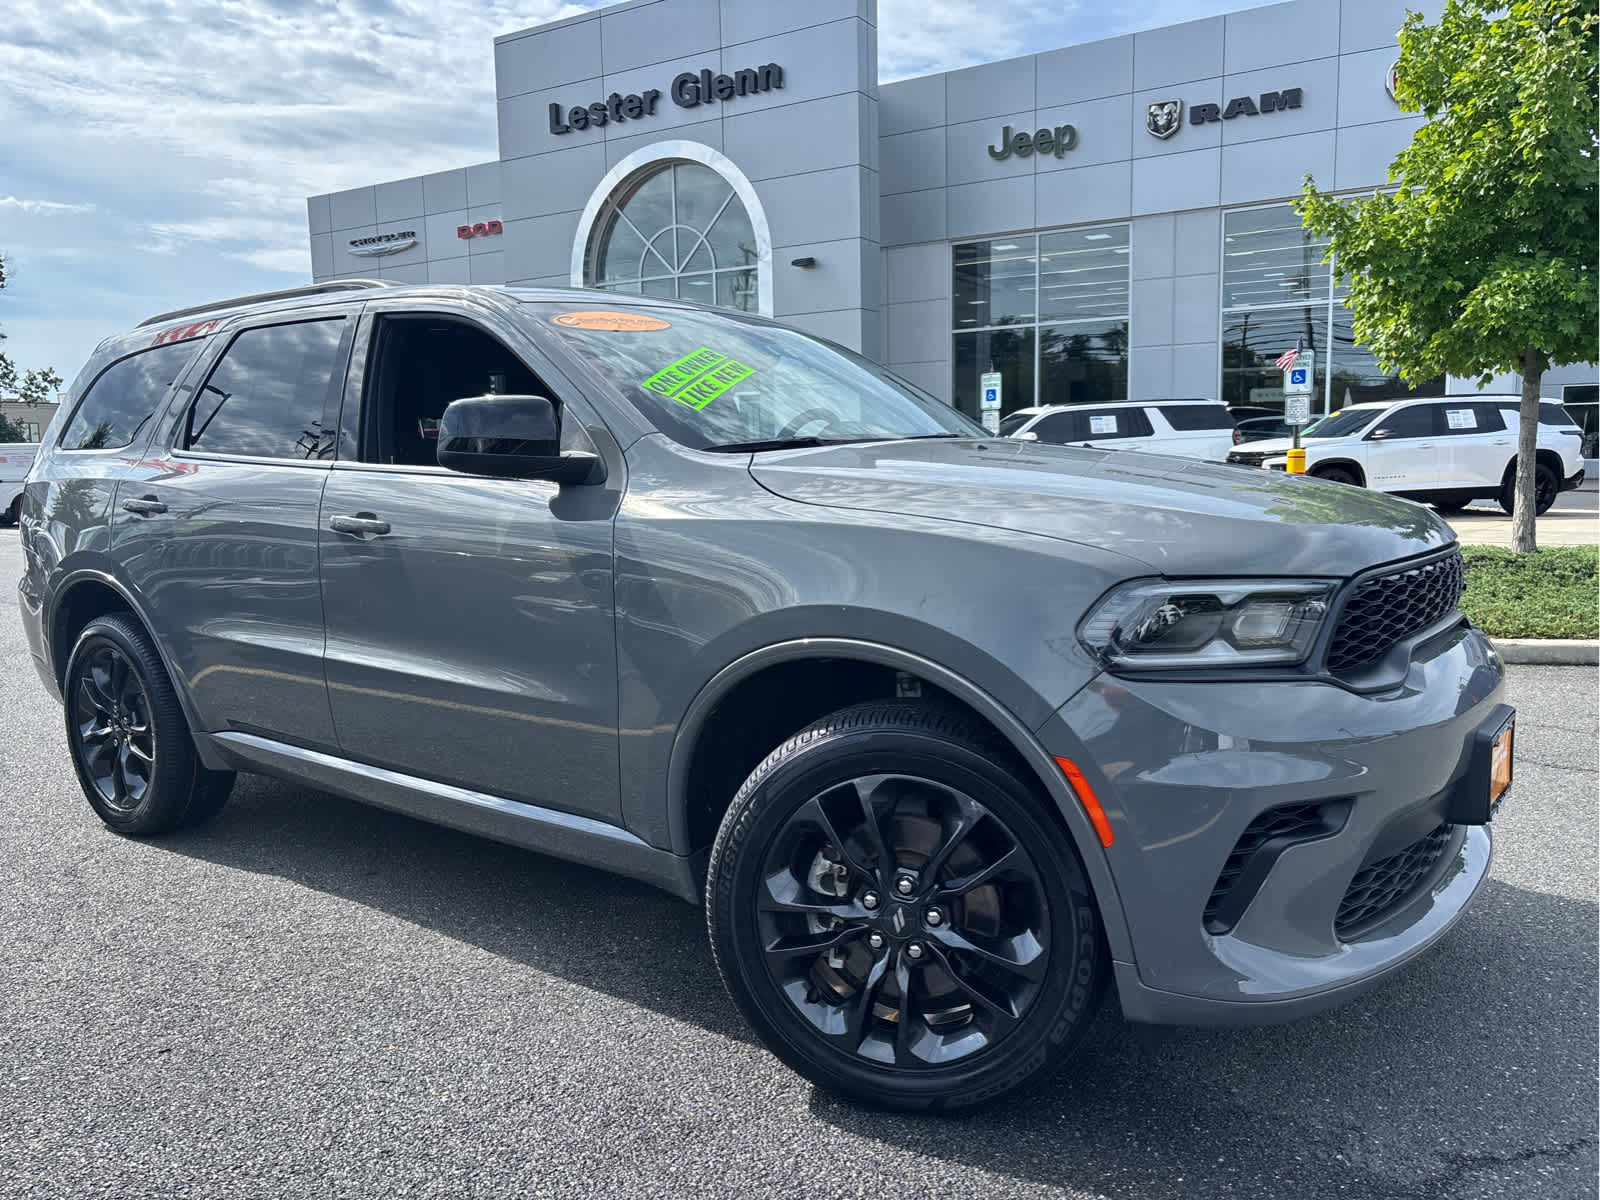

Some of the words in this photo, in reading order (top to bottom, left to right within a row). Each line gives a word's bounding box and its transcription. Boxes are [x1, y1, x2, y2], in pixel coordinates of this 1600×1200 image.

[549, 88, 661, 135] Lester
[671, 62, 784, 108] Glenn
[1189, 87, 1303, 125] RAM
[988, 124, 1077, 160] Jeep
[349, 230, 416, 247] CHRYSLER
[650, 370, 686, 393] ONE
[675, 350, 721, 376] OWNER
[678, 379, 720, 408] LIKE
[711, 362, 748, 385] NEW
